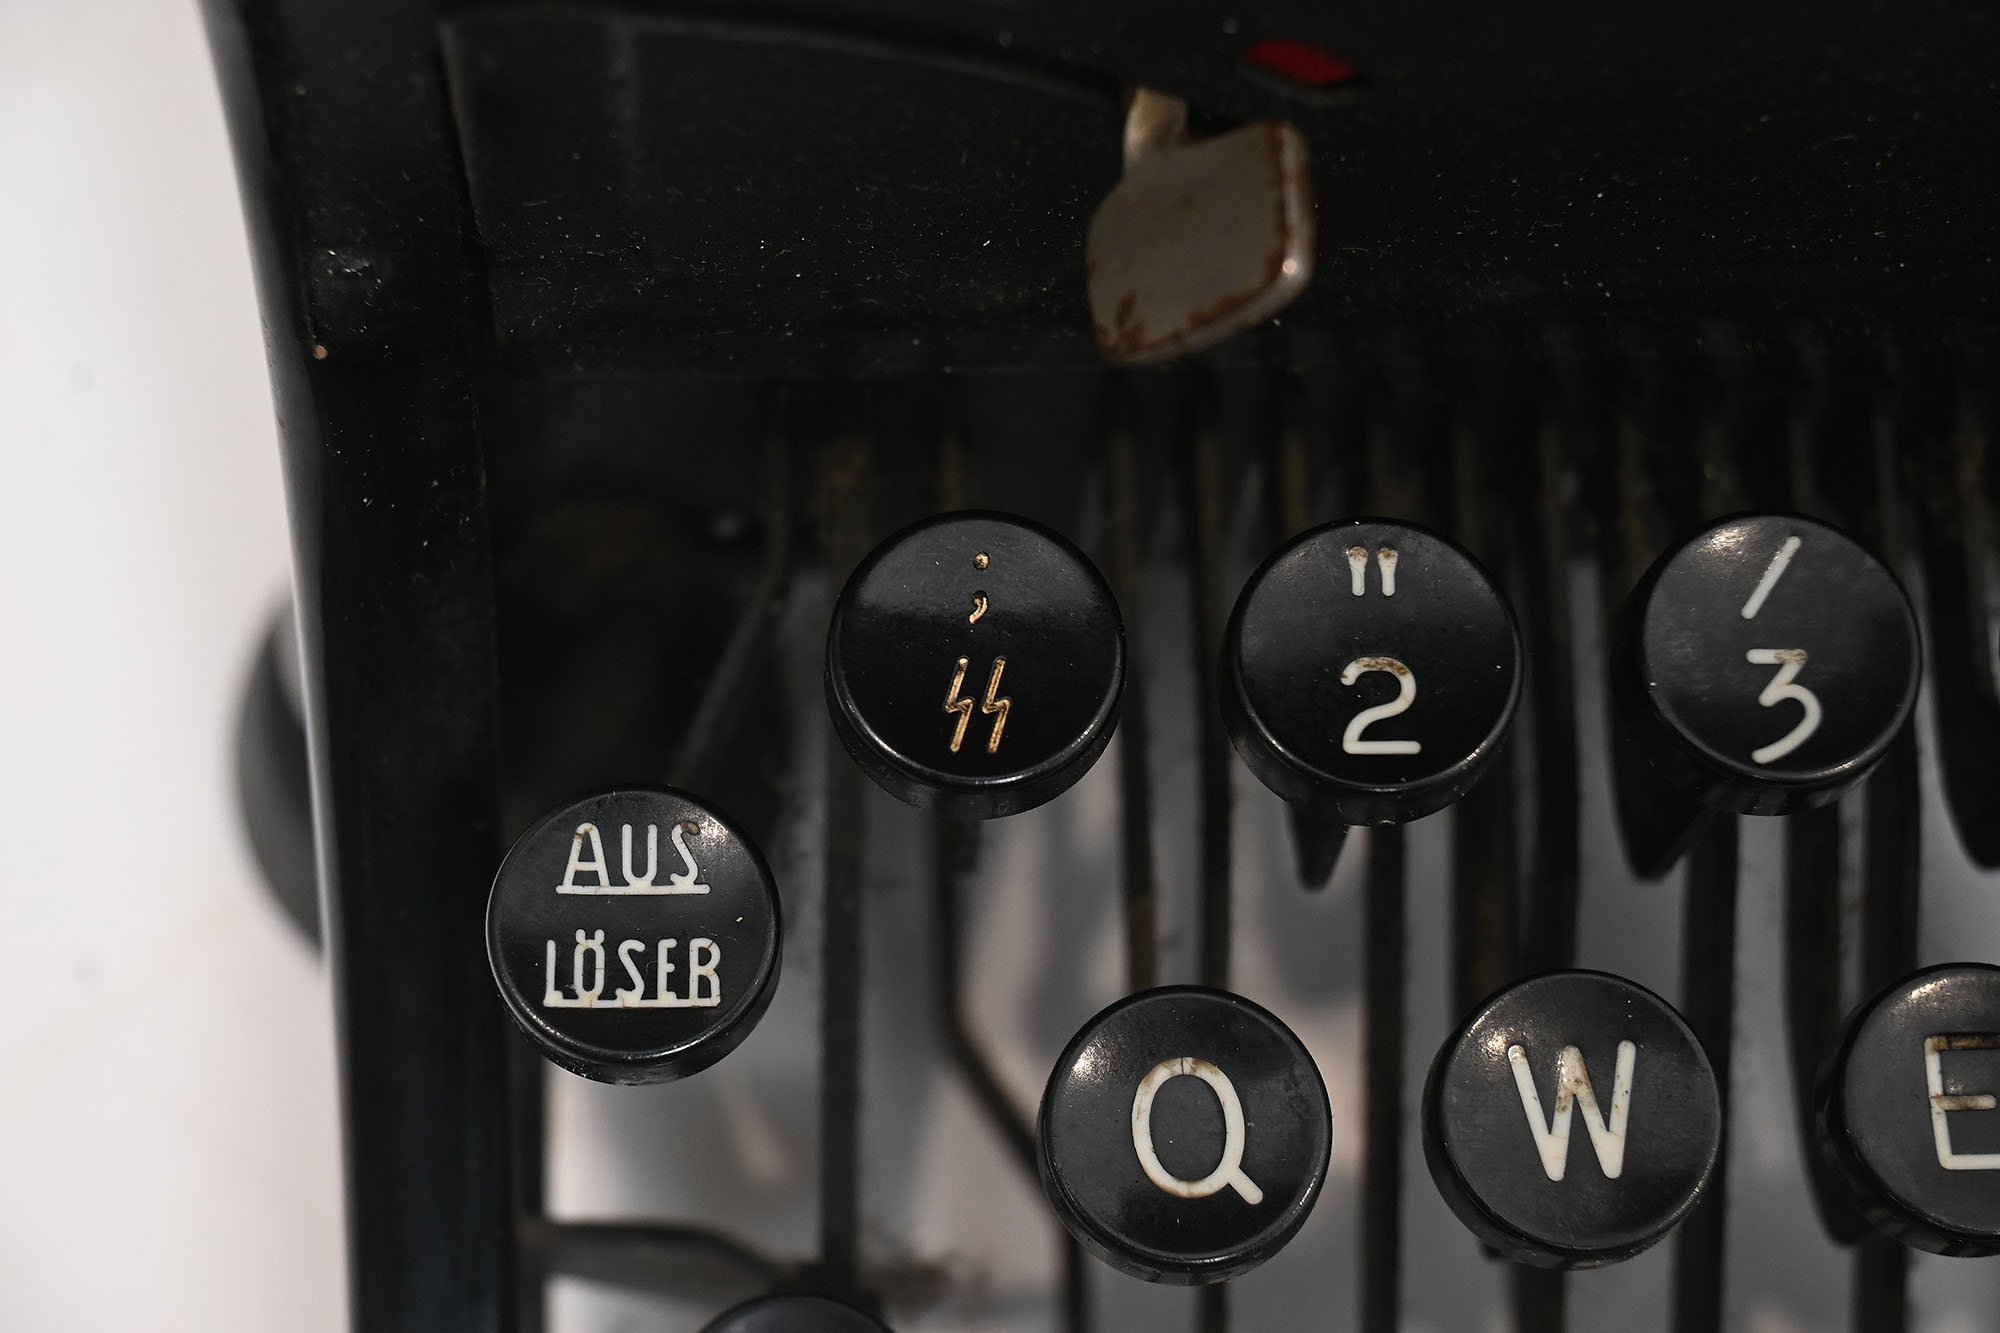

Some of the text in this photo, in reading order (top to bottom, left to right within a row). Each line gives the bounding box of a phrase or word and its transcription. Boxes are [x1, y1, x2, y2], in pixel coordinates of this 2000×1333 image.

[1340, 656, 1422, 756] 2
[1746, 648, 1822, 764] 3
[555, 821, 712, 896] AUS
[542, 928, 722, 1010] LÖSER
[1130, 1055, 1264, 1206] Q
[1506, 1040, 1637, 1182] W
[1923, 1034, 2000, 1171] E
